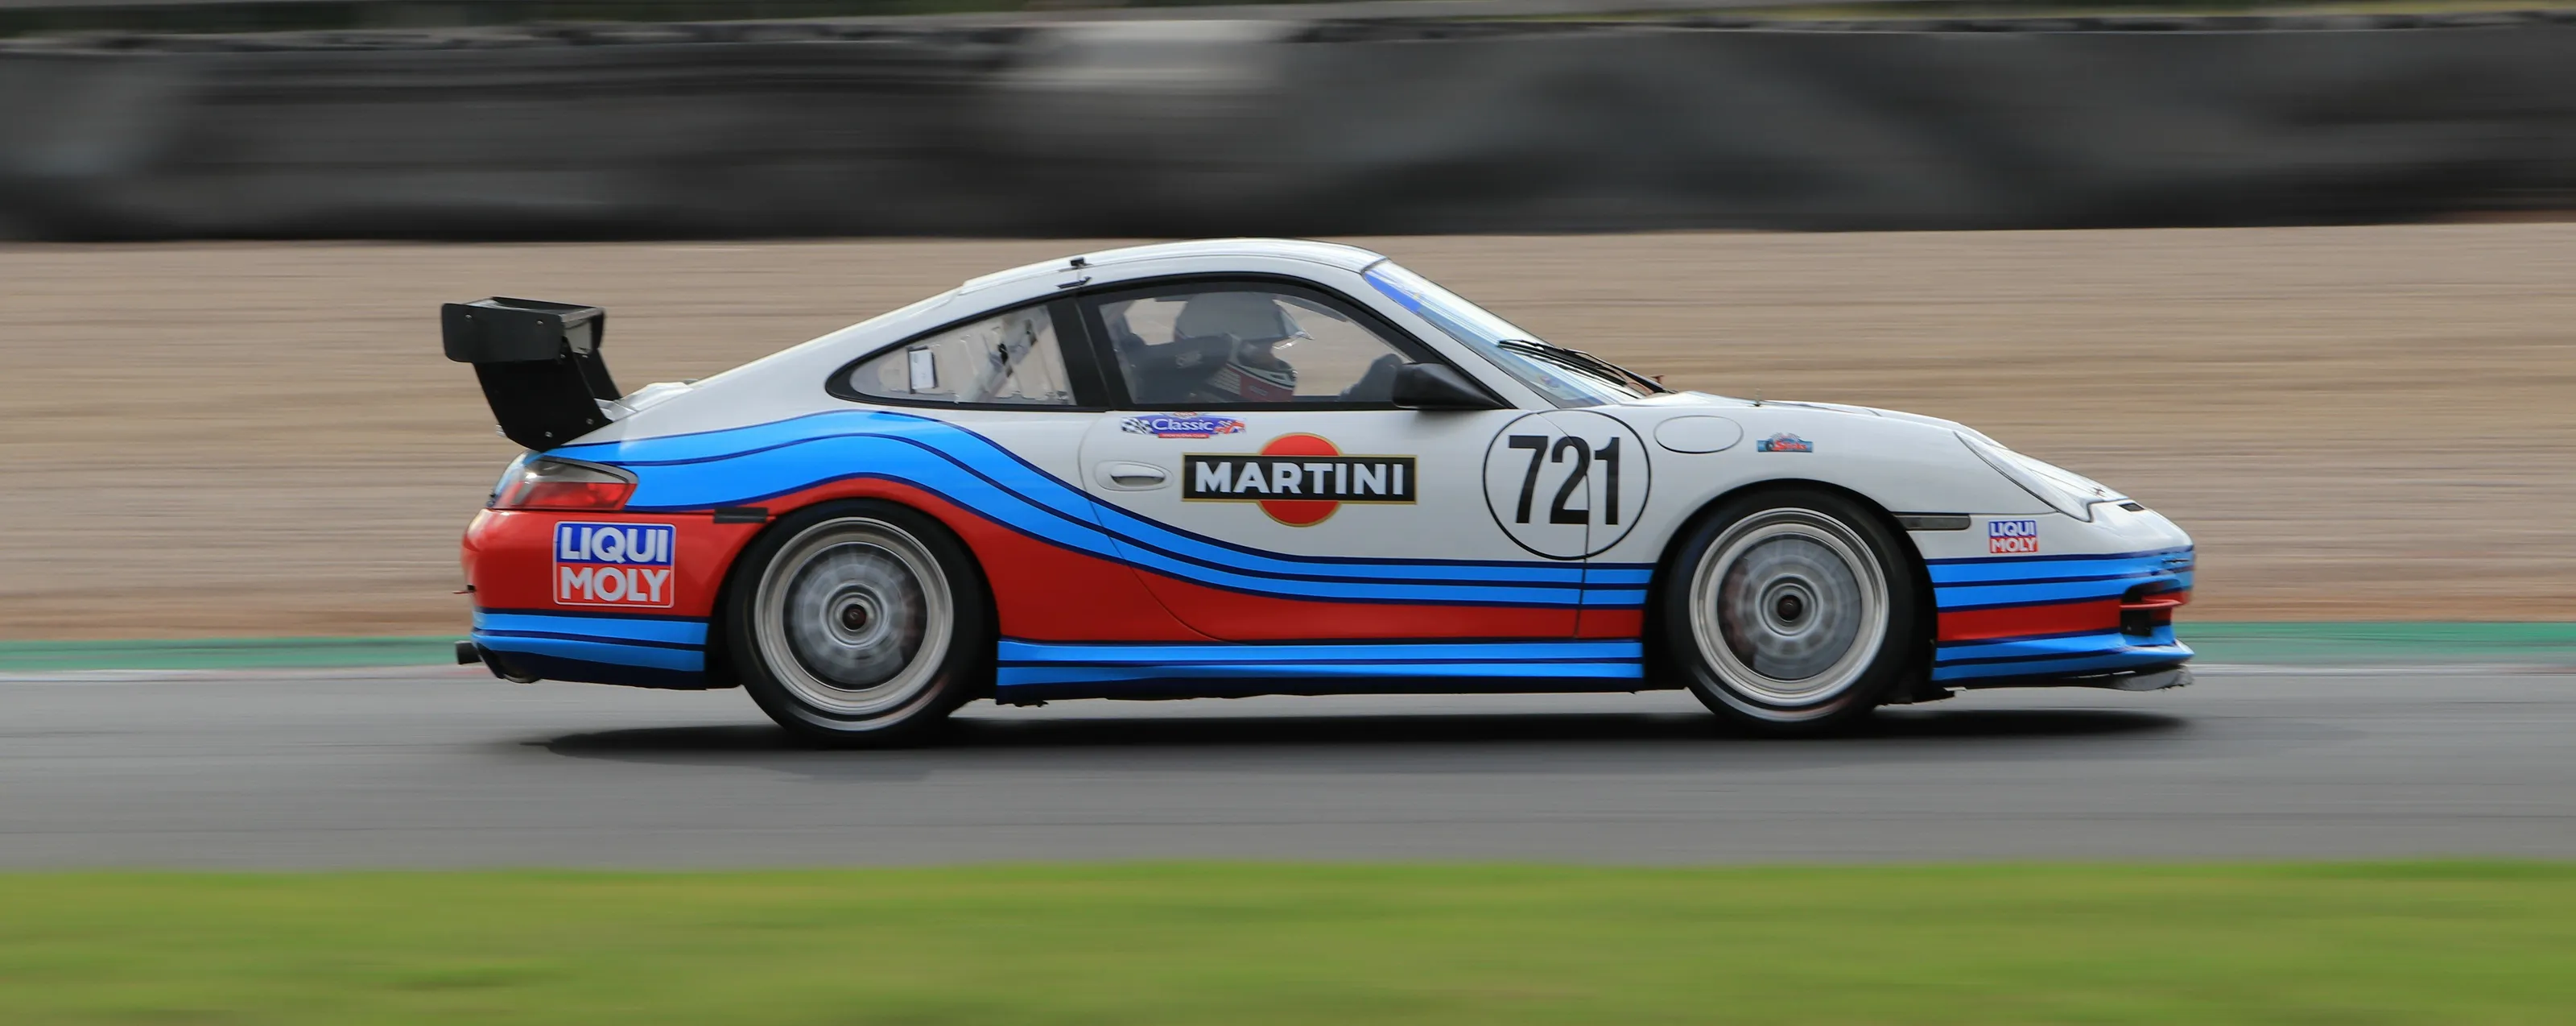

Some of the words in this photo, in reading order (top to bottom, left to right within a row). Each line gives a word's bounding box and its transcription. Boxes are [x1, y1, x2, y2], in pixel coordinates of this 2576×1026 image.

[1151, 418, 1214, 431] Classic
[1195, 461, 1403, 495] MARTINI
[1509, 435, 1620, 525] 721
[561, 527, 669, 564] LIQUI
[1990, 522, 2035, 536] LIQUI
[1991, 537, 2037, 552] MOLY
[560, 566, 671, 602] MOLY
